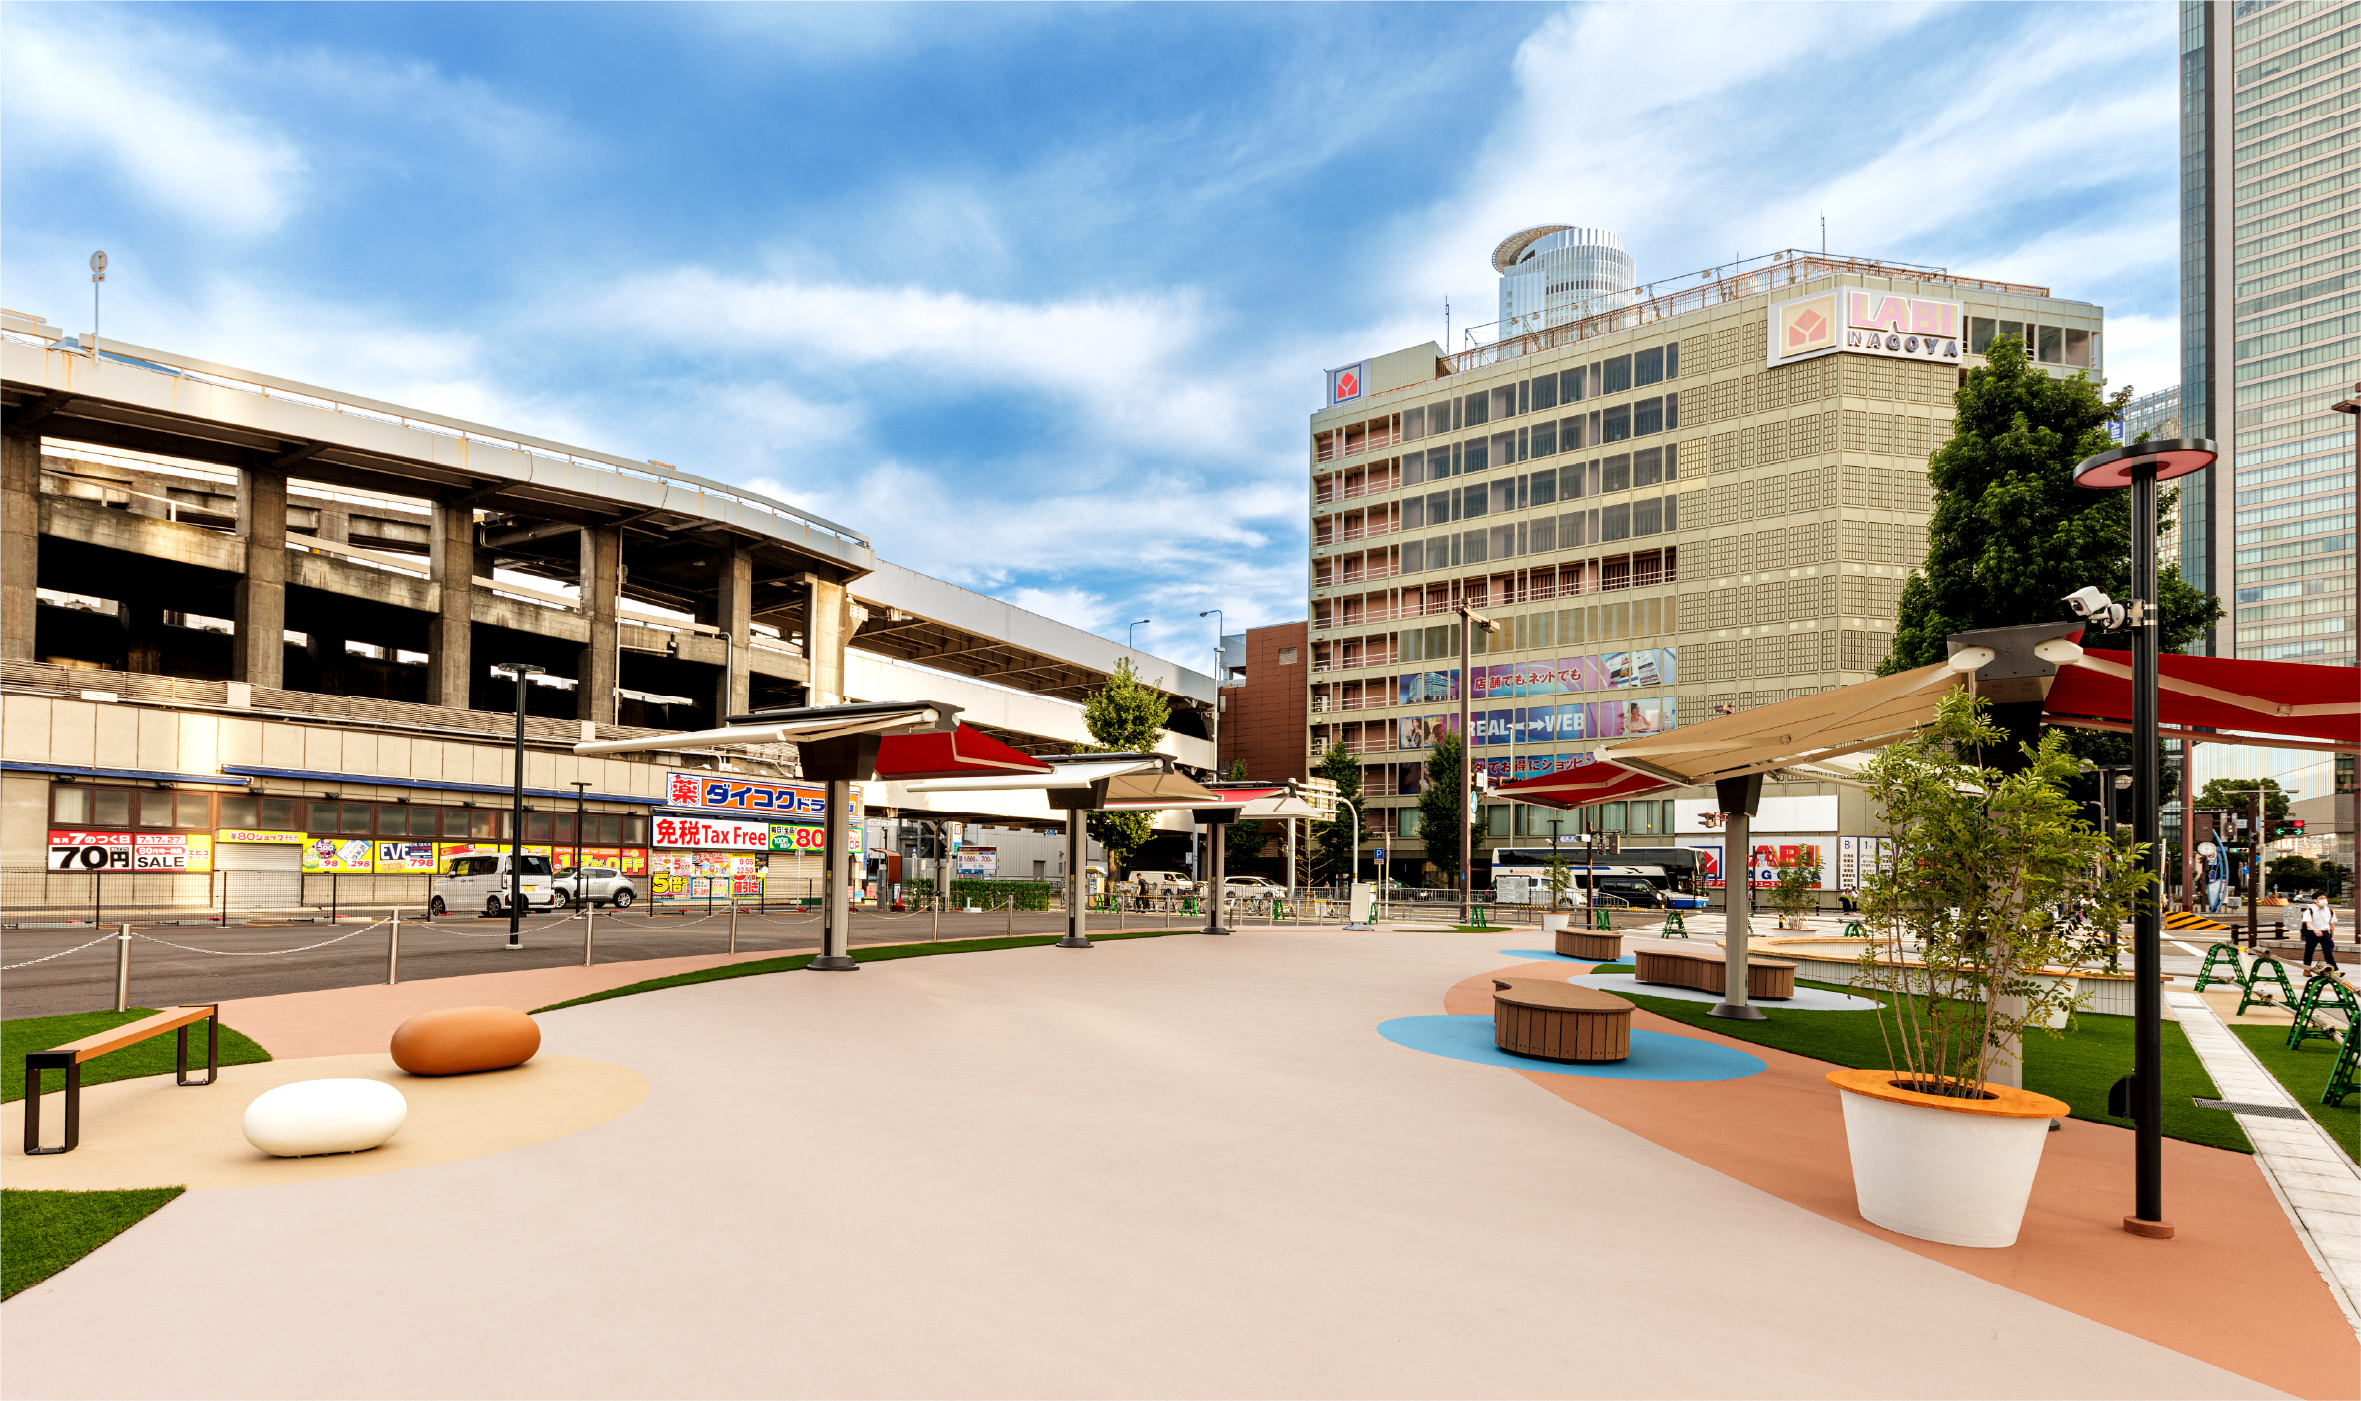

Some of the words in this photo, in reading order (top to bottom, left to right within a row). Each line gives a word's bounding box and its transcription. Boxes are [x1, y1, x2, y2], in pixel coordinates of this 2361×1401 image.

[1850, 291, 1960, 338] LABI
[1848, 330, 1958, 357] NAGOYA
[1470, 718, 1510, 737] REAL
[1545, 712, 1585, 732] WEB
[672, 775, 698, 805] 薬
[53, 833, 131, 845] 毎月7のつく日
[656, 818, 700, 846] 免税
[702, 824, 730, 845] Tax
[733, 826, 767, 846] Free
[52, 846, 130, 868] 70円
[137, 856, 185, 868] SALE
[380, 843, 411, 860] EVE
